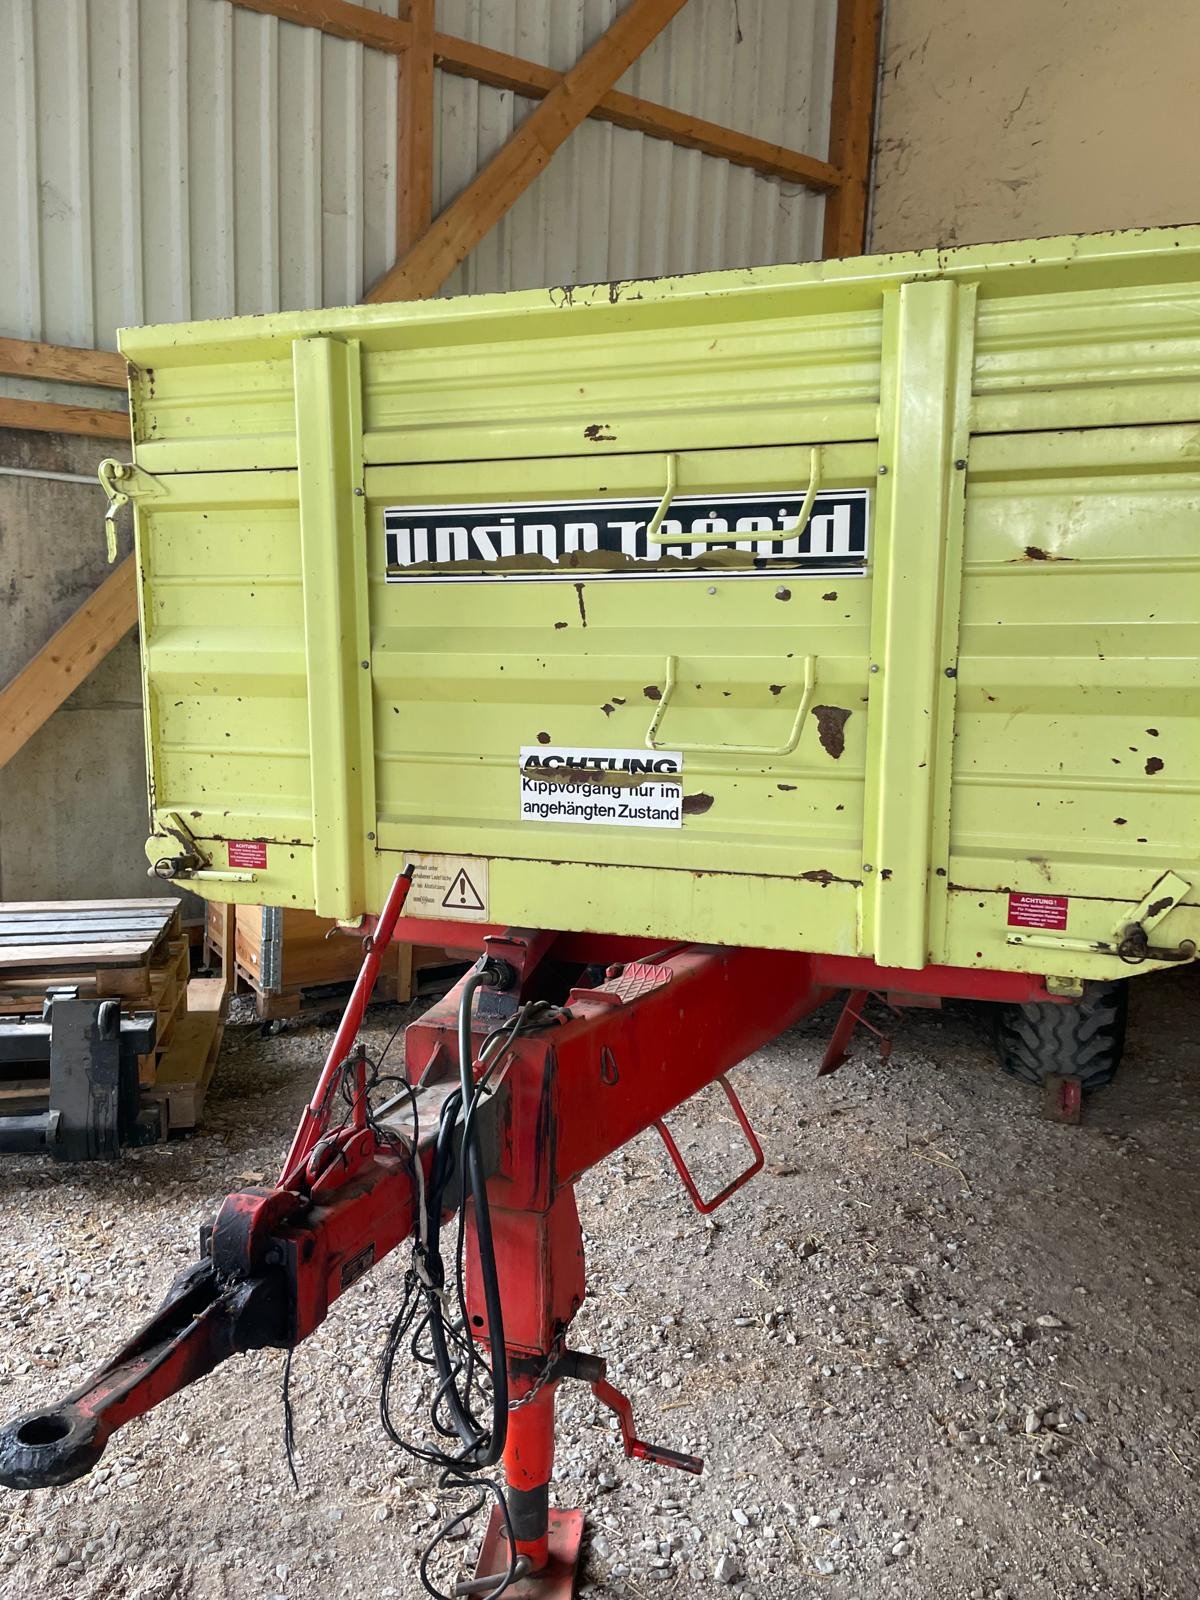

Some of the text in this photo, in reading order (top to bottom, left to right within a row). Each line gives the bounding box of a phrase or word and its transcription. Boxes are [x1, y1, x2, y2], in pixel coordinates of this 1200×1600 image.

[524, 755, 678, 774] ACHTUNG
[522, 778, 680, 798] Kippvorgang nur im
[523, 801, 679, 820] angehängten Zustand
